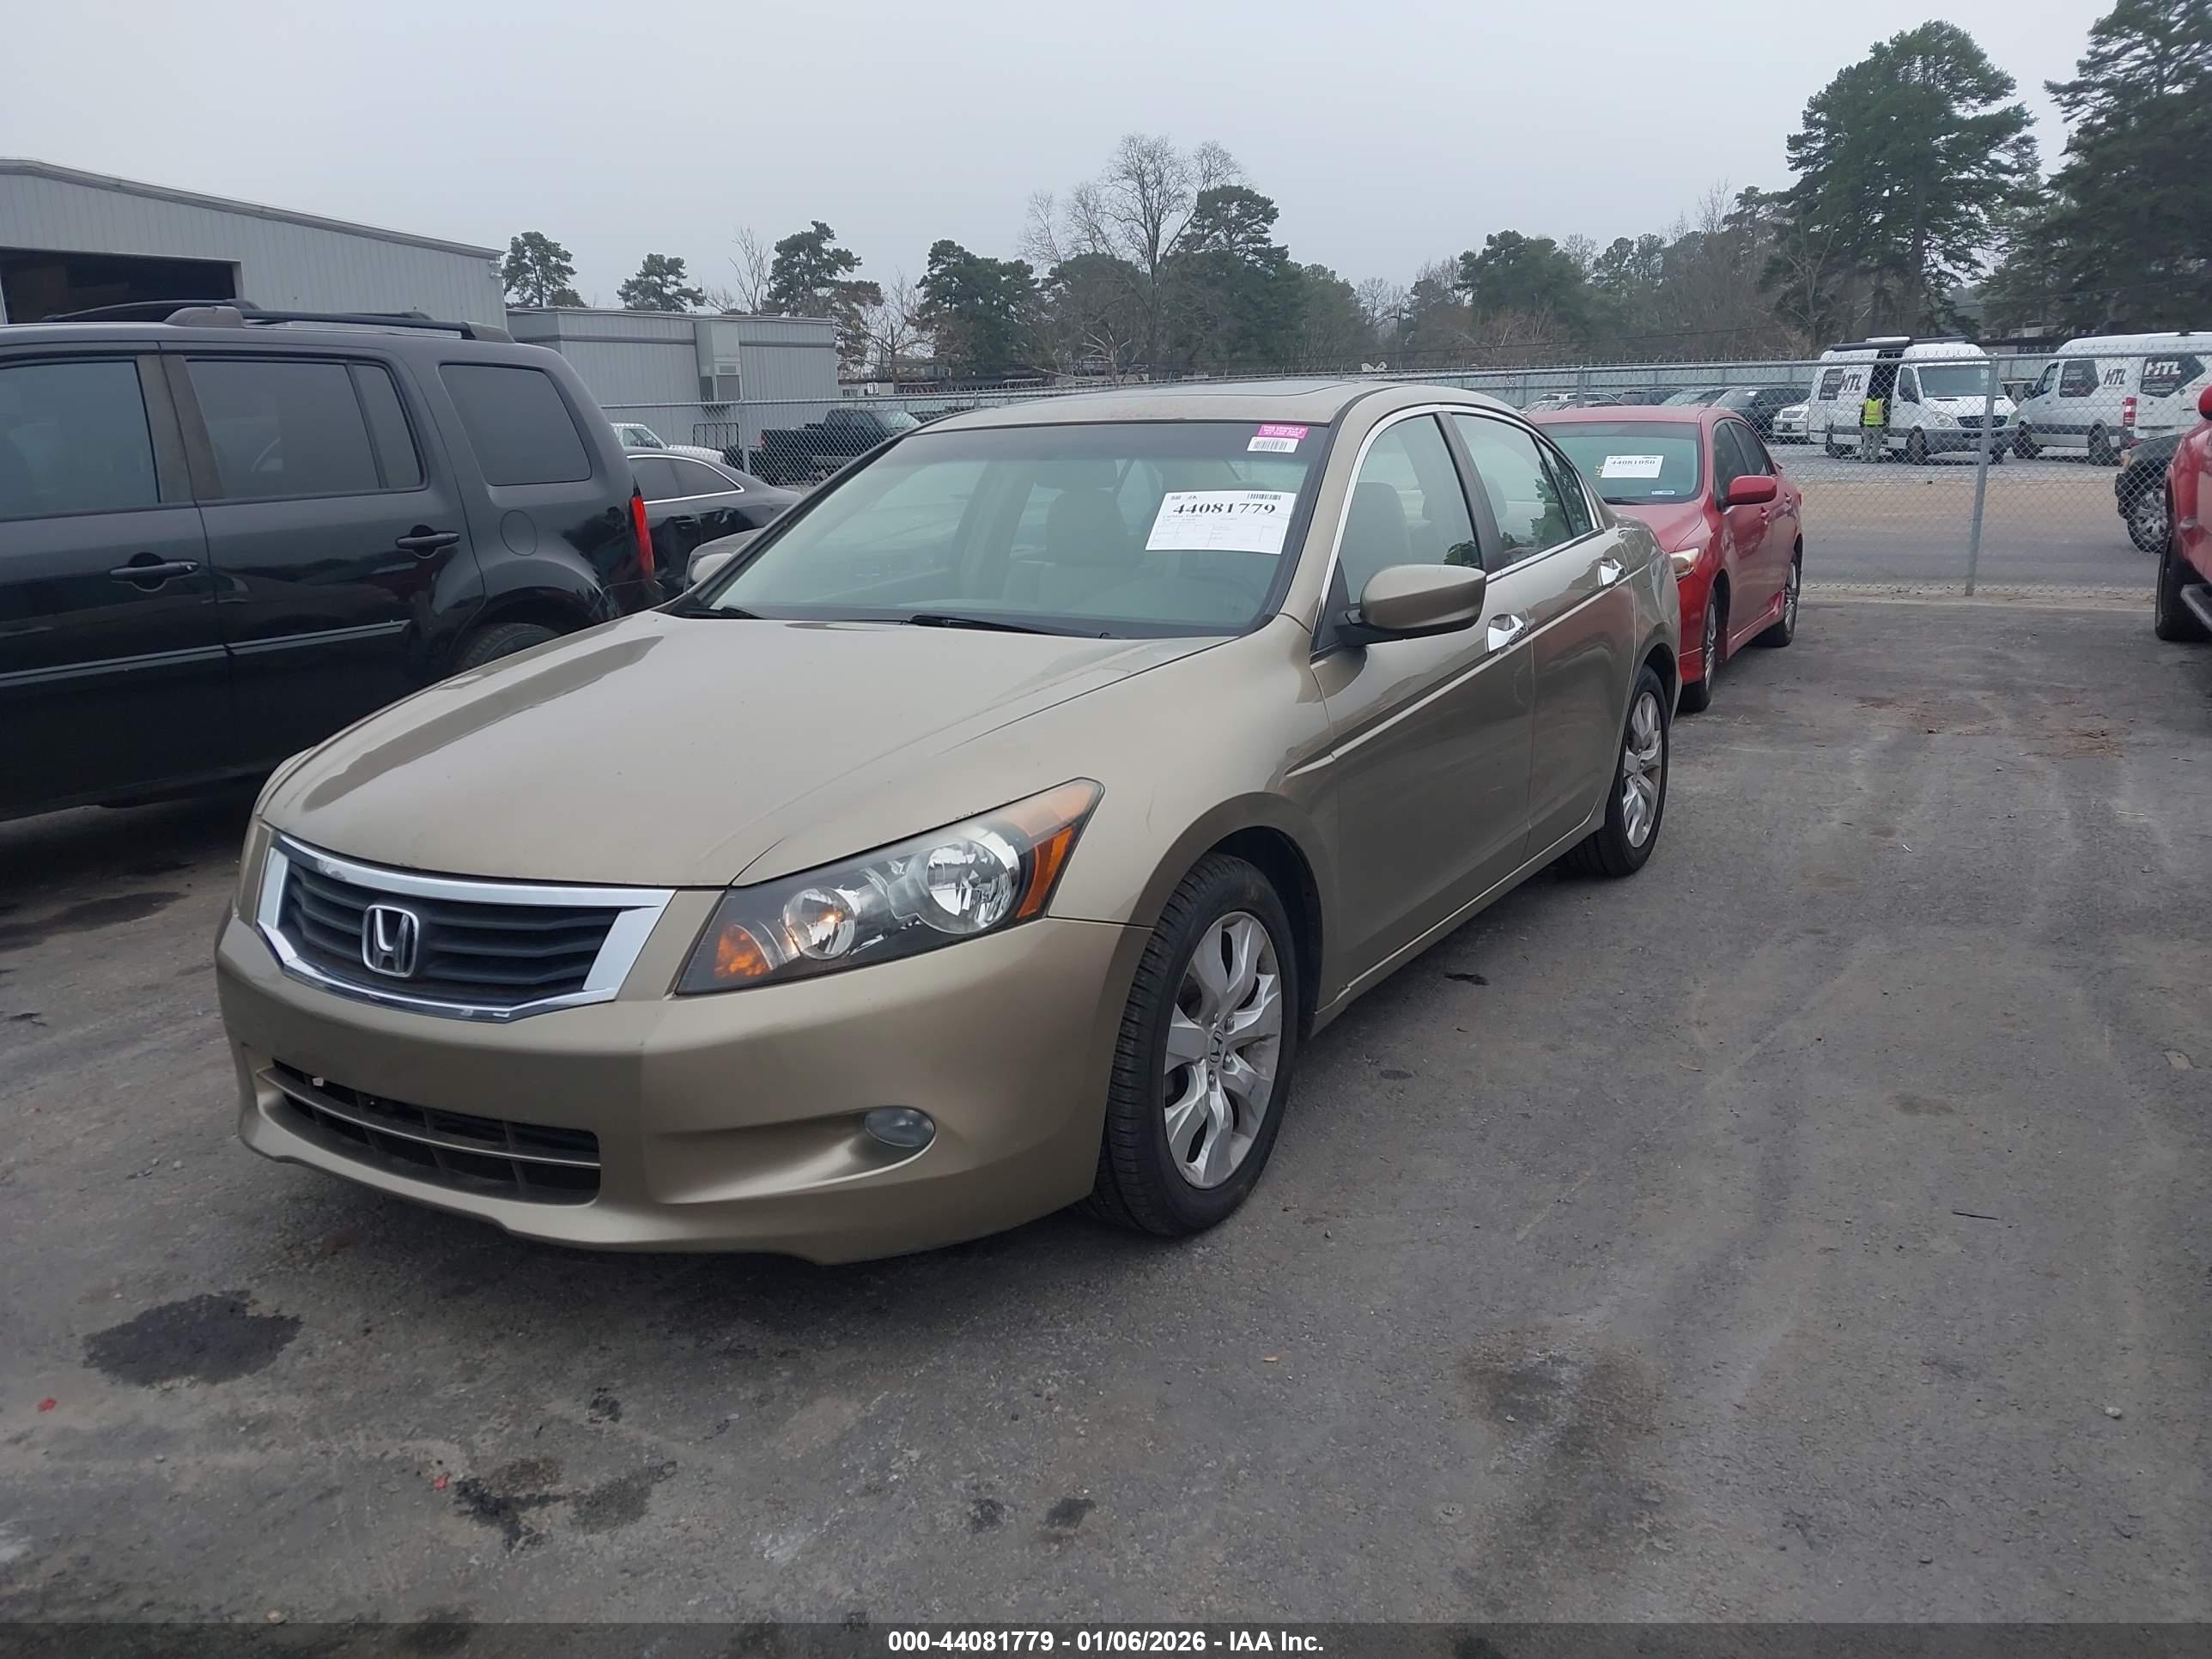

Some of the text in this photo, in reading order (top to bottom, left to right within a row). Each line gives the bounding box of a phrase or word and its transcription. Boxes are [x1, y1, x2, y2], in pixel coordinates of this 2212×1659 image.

[2143, 362, 2183, 376] HTL
[2104, 368, 2127, 385] HTL
[1173, 502, 1276, 514] 44081779
